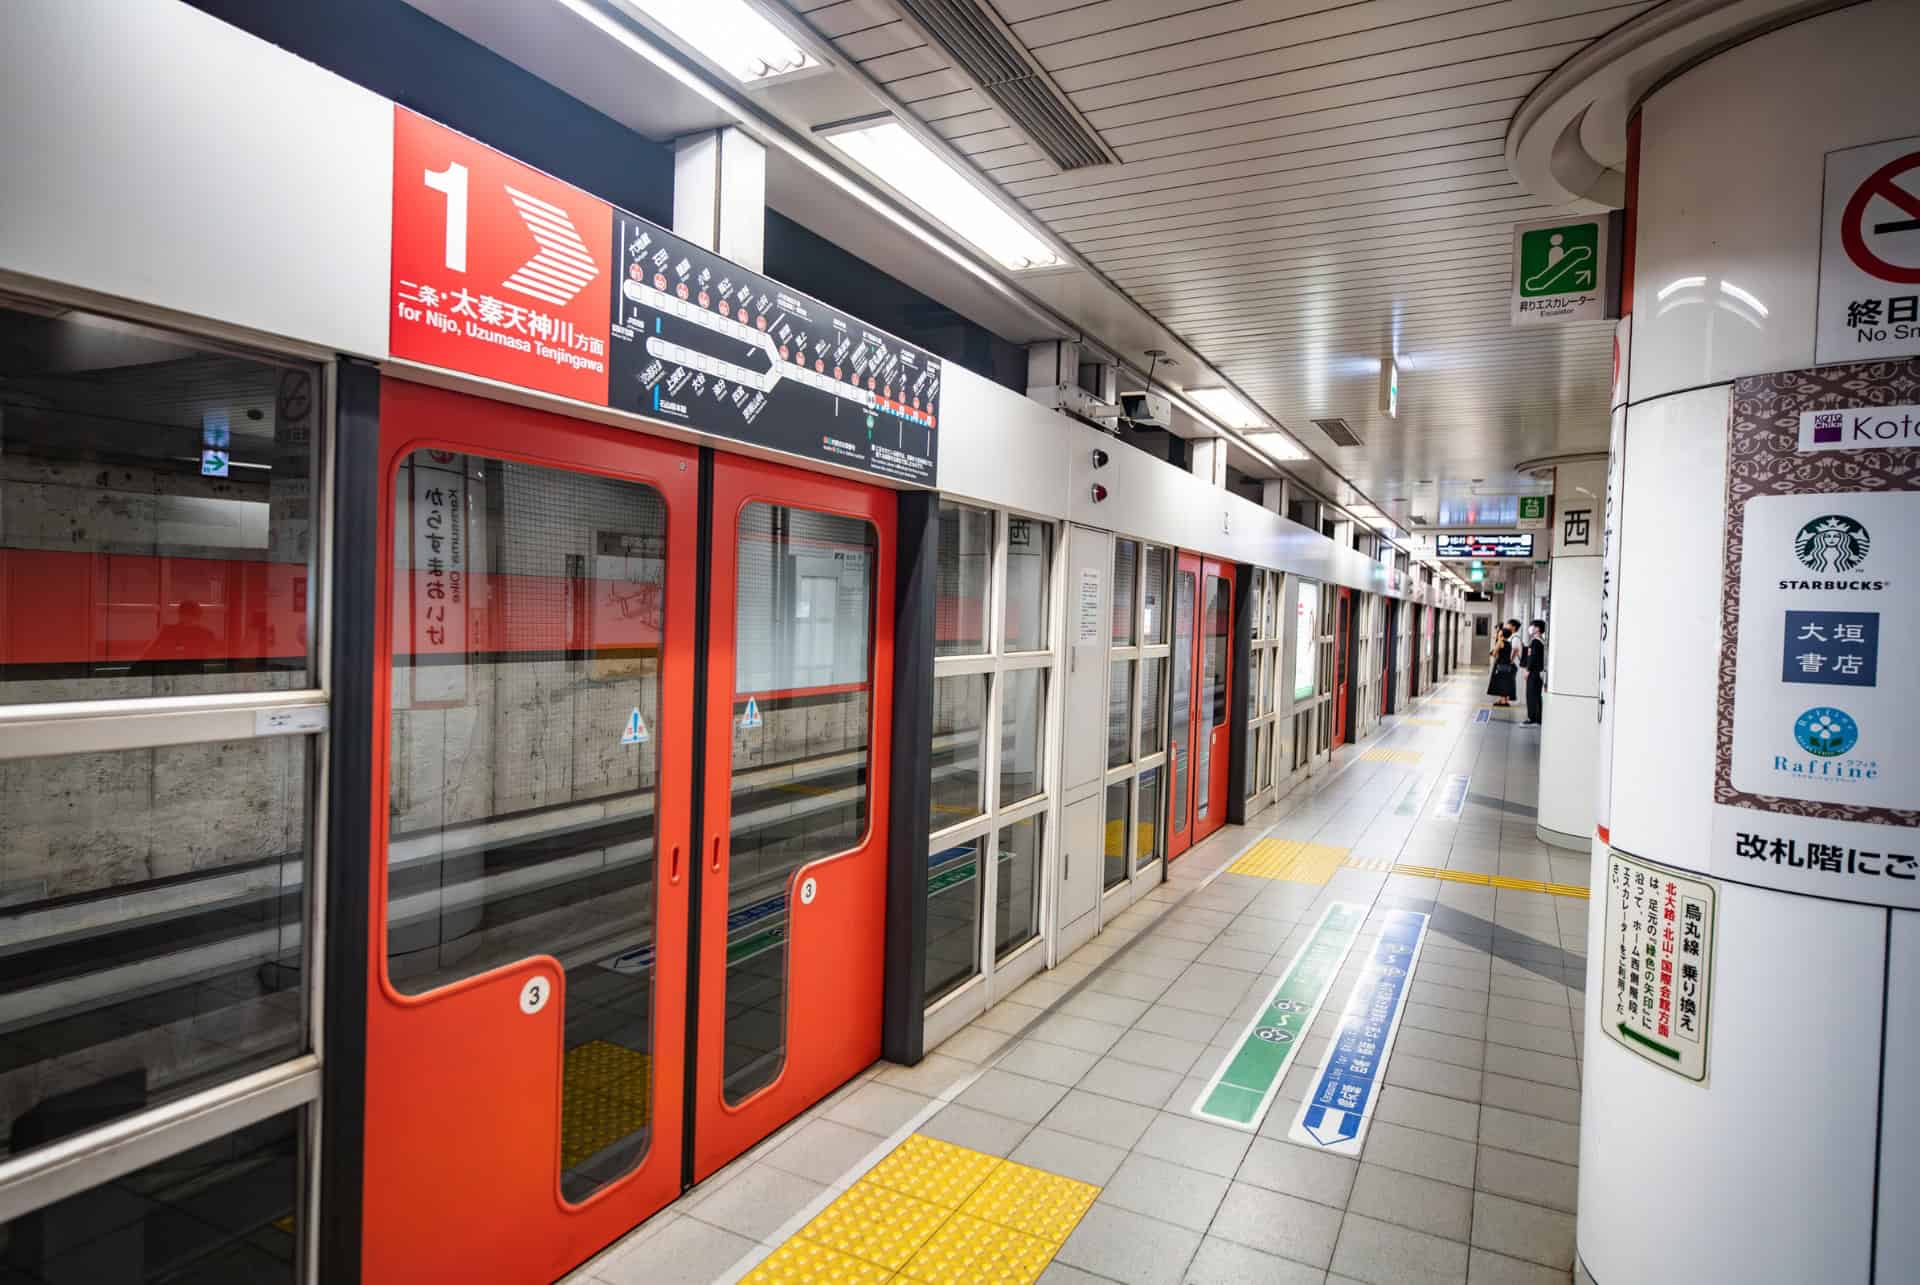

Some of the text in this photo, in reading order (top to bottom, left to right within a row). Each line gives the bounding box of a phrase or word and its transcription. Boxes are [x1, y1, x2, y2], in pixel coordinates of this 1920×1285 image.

[424, 161, 468, 273] 1
[1520, 296, 1596, 313] 昇りエスカレーター
[398, 302, 604, 373] for Nijo, Uzumasa Tenjingawa
[1858, 327, 1888, 343] No
[1854, 414, 1920, 441] Kot
[1564, 509, 1592, 546] 西
[1779, 580, 1885, 591] STARBUCKS
[1797, 622, 1865, 643] 大垣
[1795, 652, 1864, 675] 書店
[1774, 756, 1879, 779] Raffine
[1736, 832, 1919, 881] 改札階にご
[805, 883, 813, 898] 3
[528, 985, 541, 1006] 3
[1680, 963, 1698, 1032] 乗り換え
